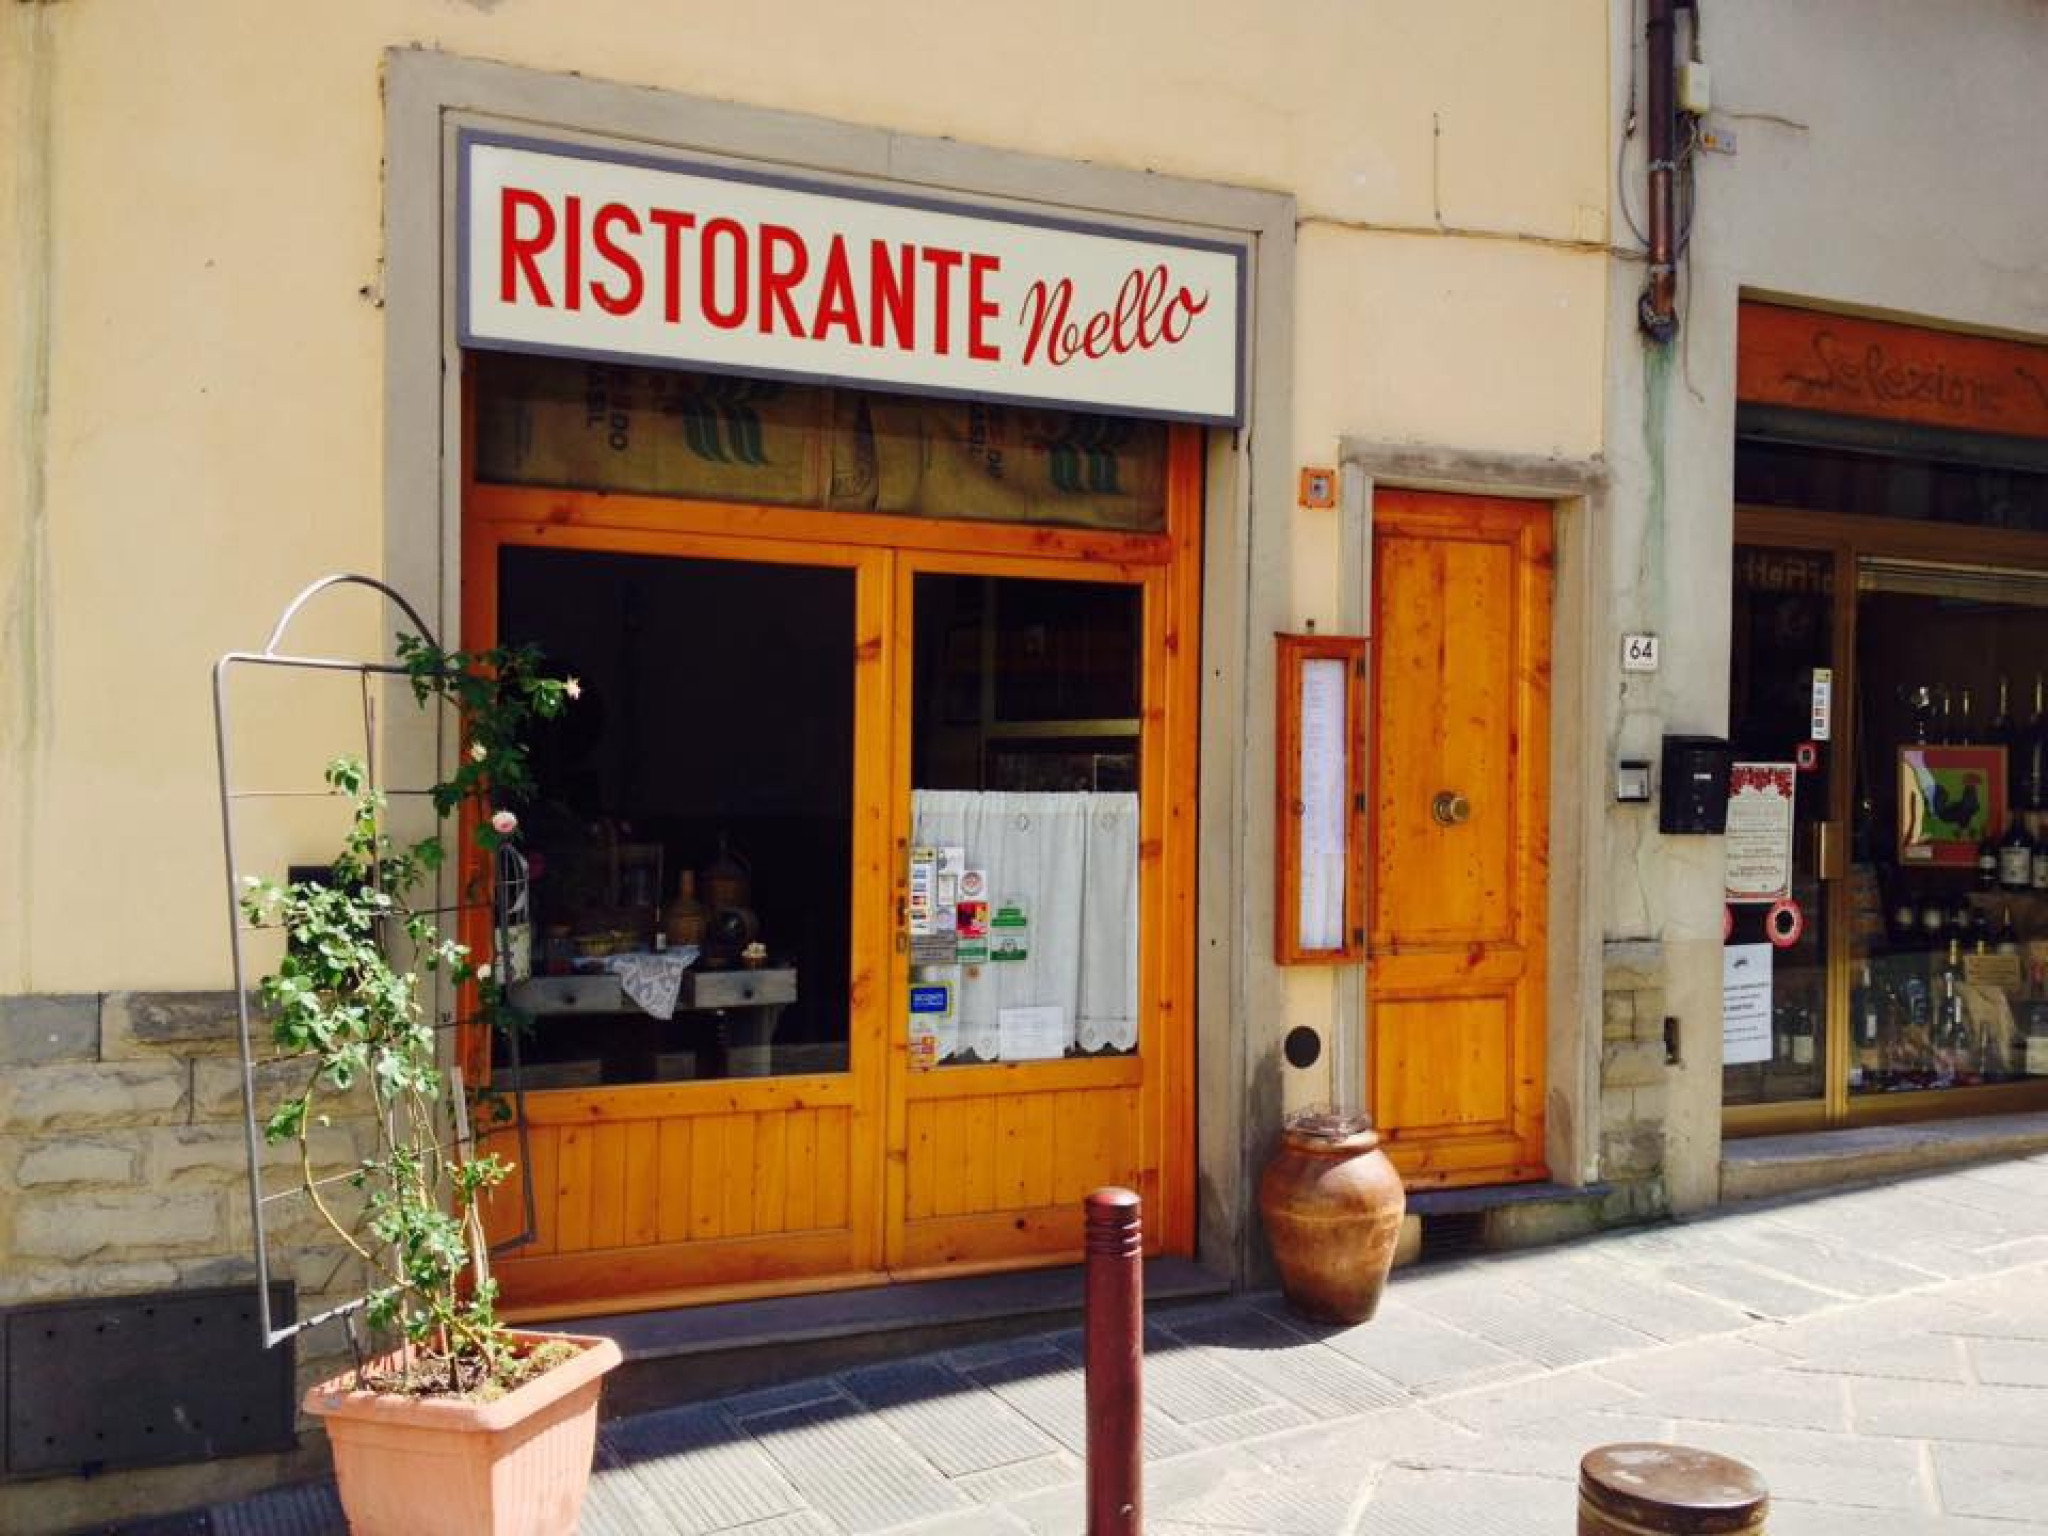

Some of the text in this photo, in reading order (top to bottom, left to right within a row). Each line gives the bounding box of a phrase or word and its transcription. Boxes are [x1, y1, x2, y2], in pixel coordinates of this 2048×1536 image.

[501, 187, 1210, 367] RISTORANTE Nello
[1630, 640, 1652, 660] 64
